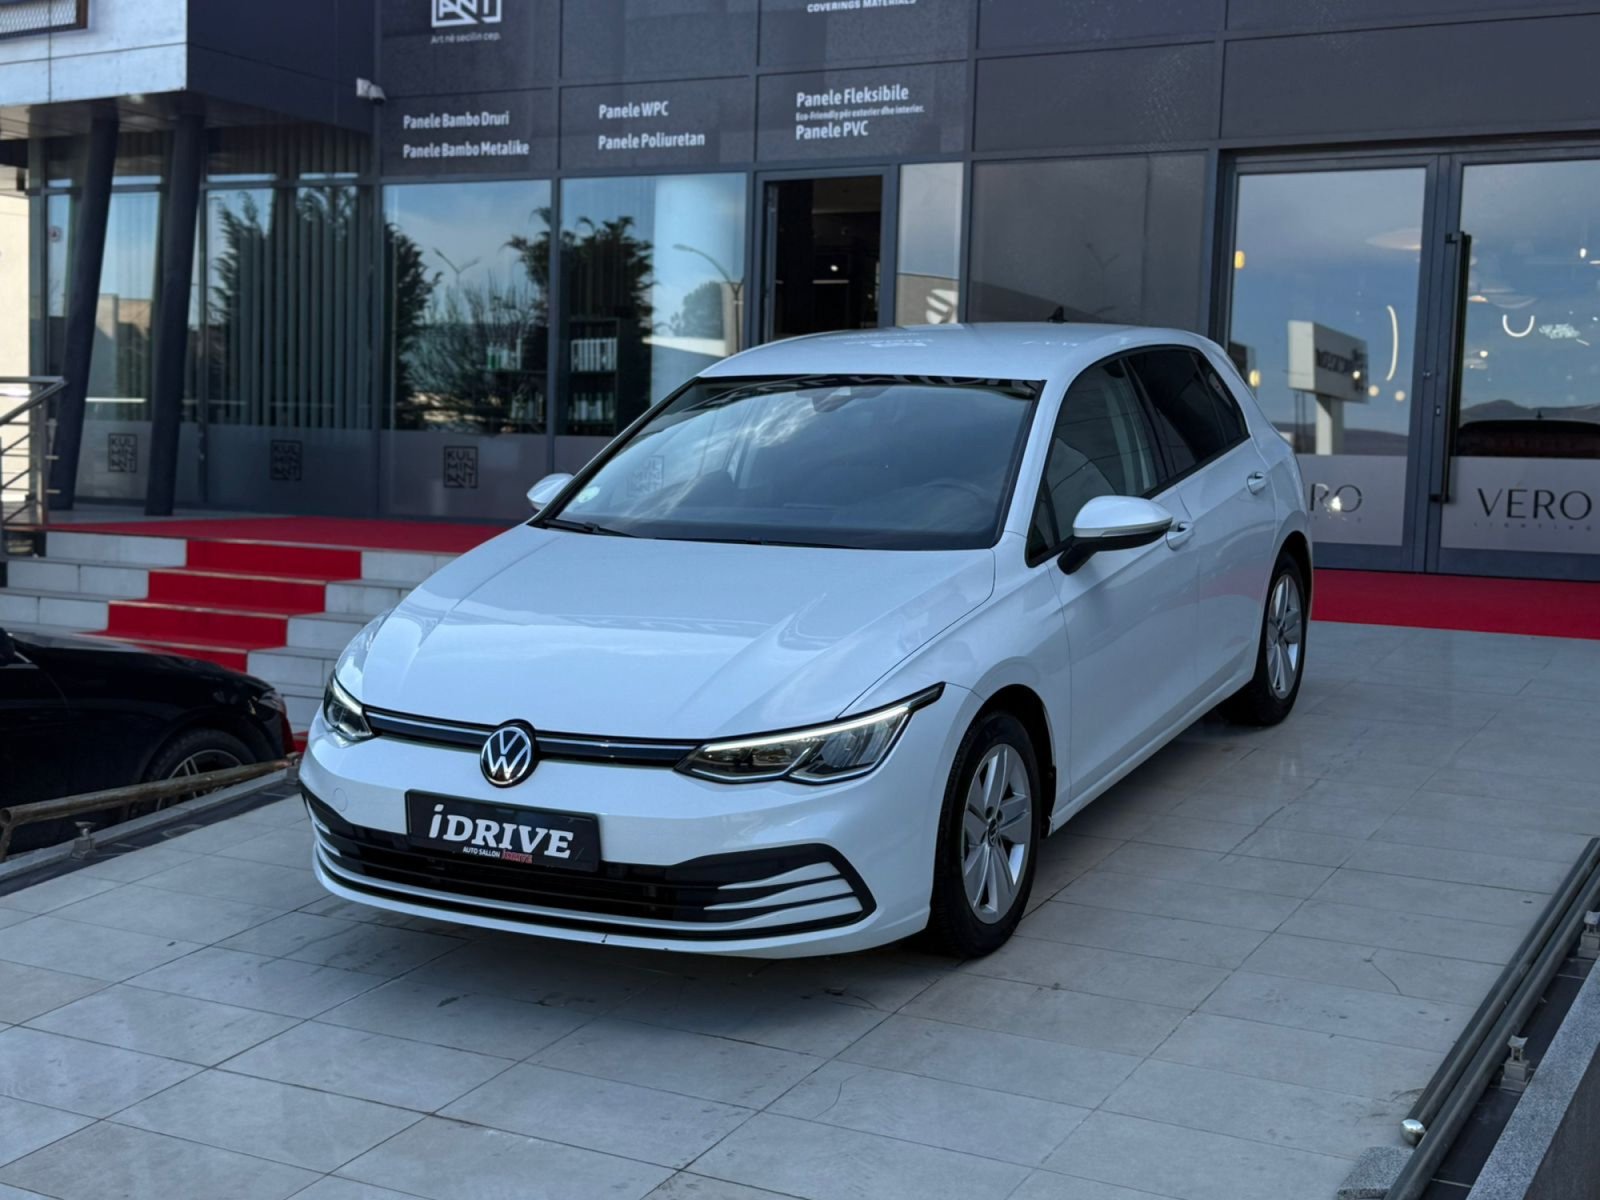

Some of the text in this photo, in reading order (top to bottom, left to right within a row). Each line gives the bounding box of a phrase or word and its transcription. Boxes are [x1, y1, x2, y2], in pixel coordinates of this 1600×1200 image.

[807, 0, 860, 12] COVERINGS
[796, 84, 909, 107] Panele Fleksibile
[598, 100, 669, 119] Panele WPC
[403, 110, 509, 129] Panele Bambo Druri
[796, 120, 868, 140] Panele PVC
[403, 140, 529, 158] Panele Bambo Metalike
[598, 131, 705, 150] Panele Poliuretan
[1310, 483, 1362, 513] RO
[462, 846, 477, 855] AUTO
[478, 848, 500, 858] SALLON
